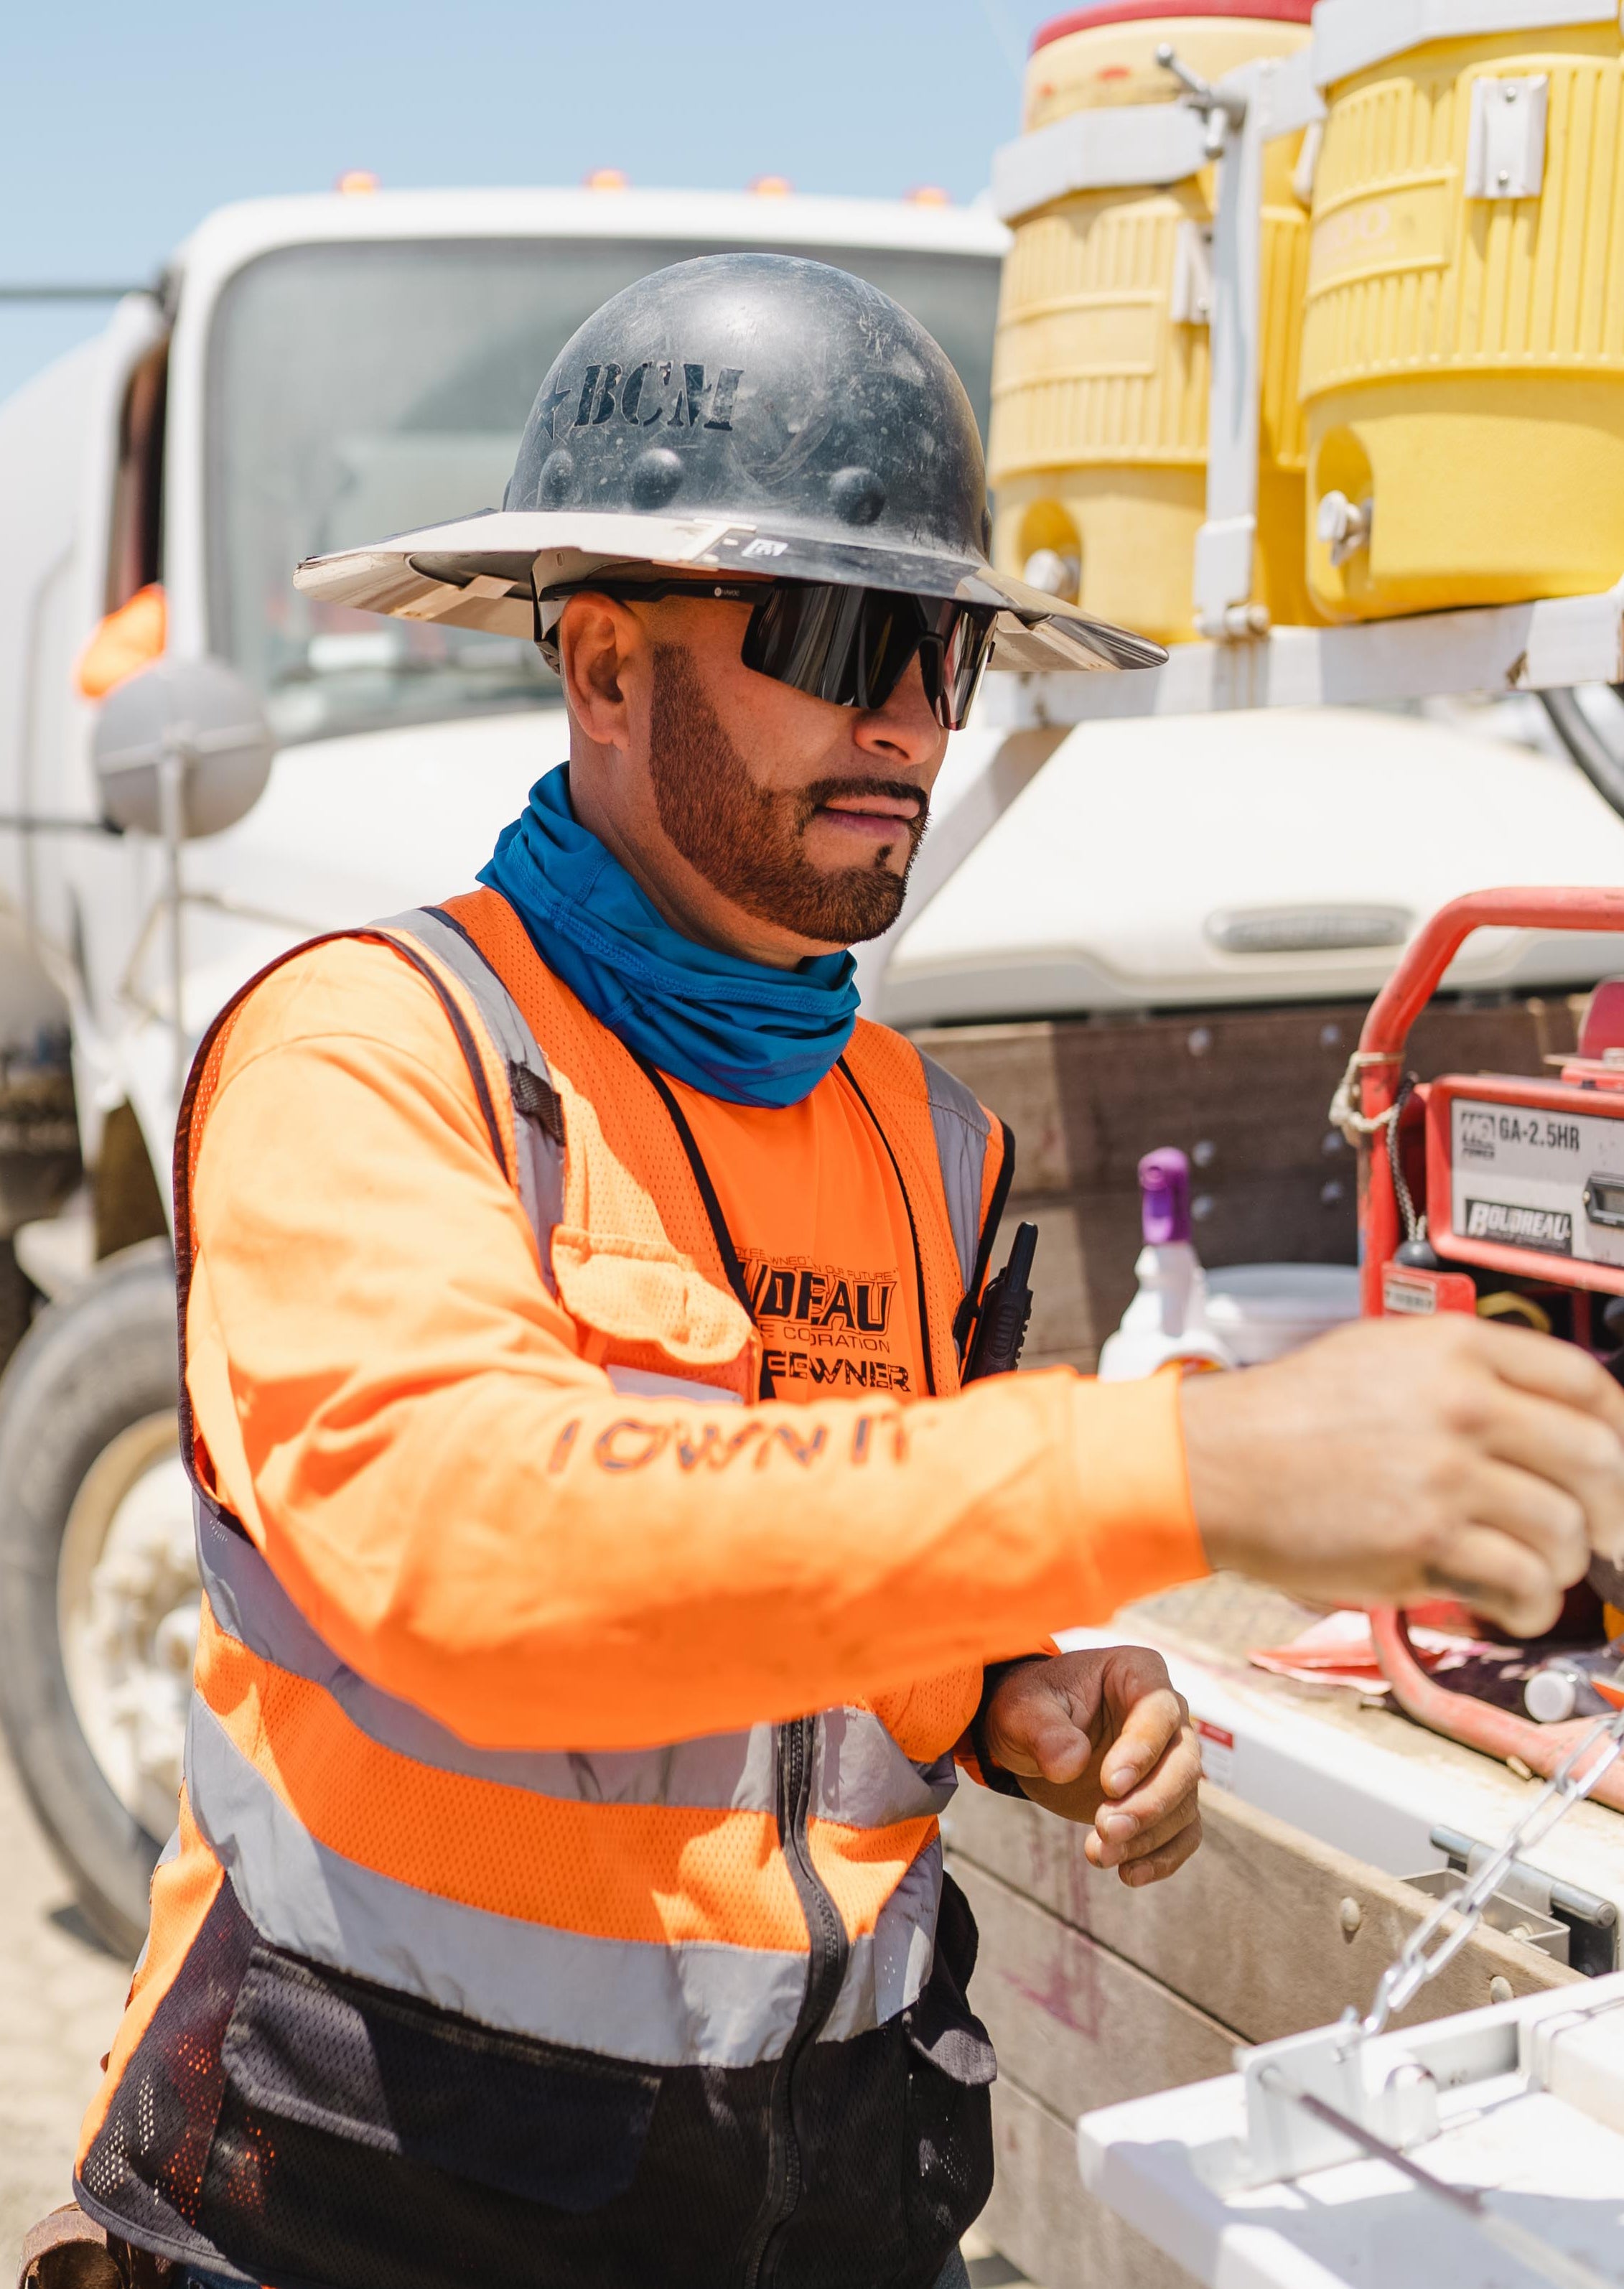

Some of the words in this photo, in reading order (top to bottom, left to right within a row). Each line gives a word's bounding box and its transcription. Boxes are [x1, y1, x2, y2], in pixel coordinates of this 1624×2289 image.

[574, 362, 745, 431] BCM
[1500, 1117, 1579, 1152] GA-2.5HR
[549, 1417, 582, 1474] I
[593, 1417, 829, 1475] OWN
